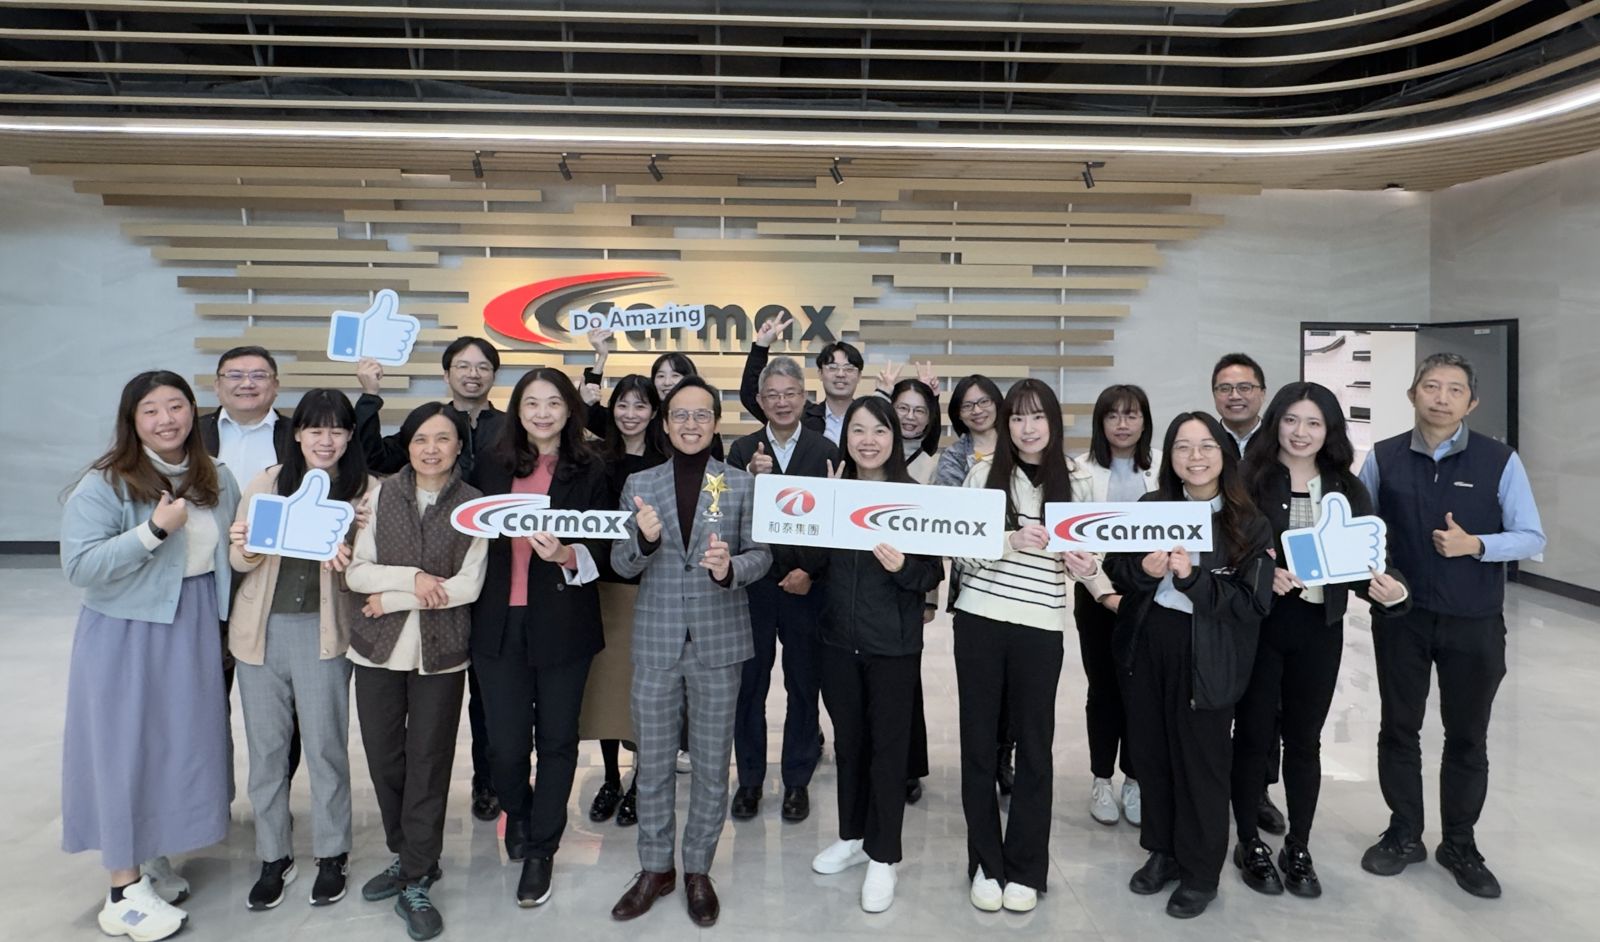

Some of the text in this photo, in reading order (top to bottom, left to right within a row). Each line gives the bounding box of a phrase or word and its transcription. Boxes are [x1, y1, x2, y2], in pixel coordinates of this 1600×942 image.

[573, 306, 700, 331] Do Amazing
[503, 513, 623, 534] carmax
[768, 521, 820, 536] 和泰集團
[888, 515, 987, 537] carmax
[1096, 524, 1203, 541] carmax
